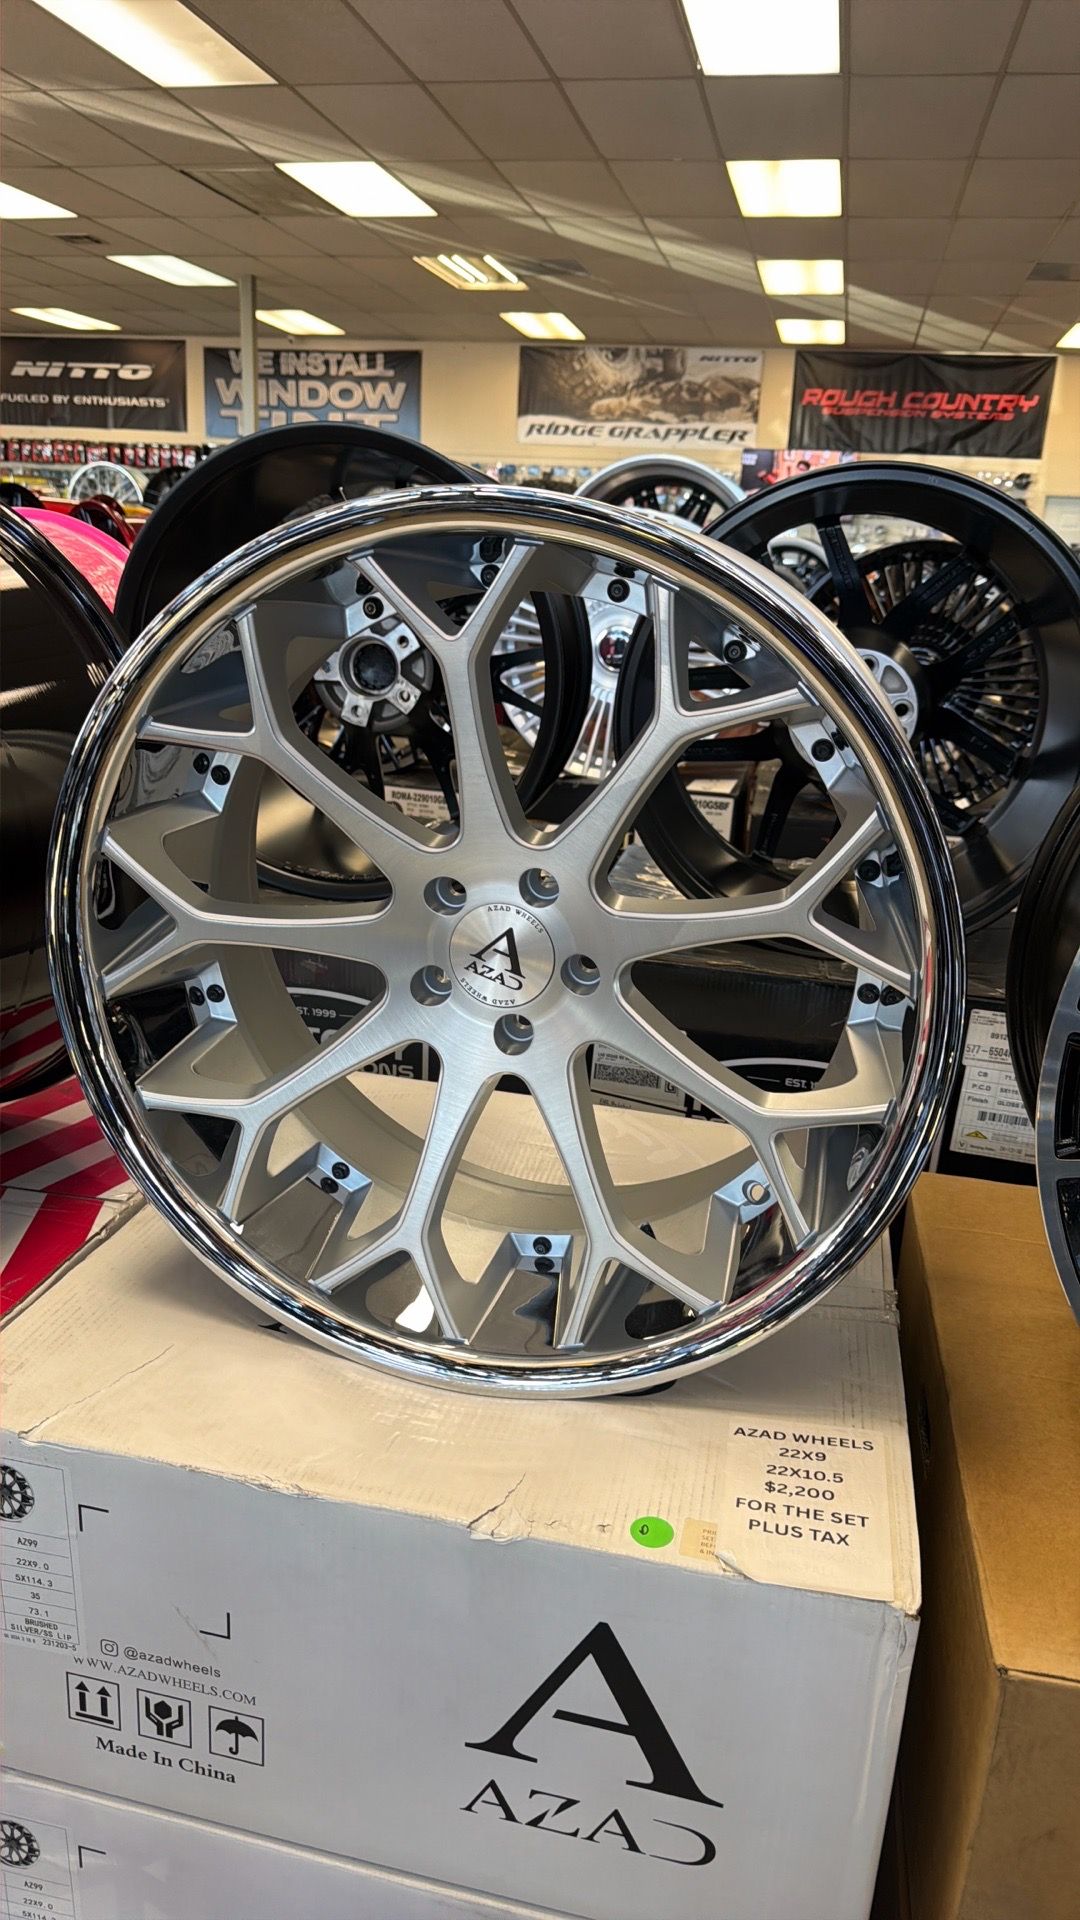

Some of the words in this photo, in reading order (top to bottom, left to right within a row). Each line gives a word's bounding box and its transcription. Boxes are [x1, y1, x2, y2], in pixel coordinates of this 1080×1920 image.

[279, 351, 395, 377] INSTALL
[700, 355, 758, 364] NITTO
[10, 360, 153, 381] NITTO
[0, 393, 49, 404] FUELED
[52, 394, 70, 405] BY
[73, 395, 166, 408] ENTHUSIASTS
[215, 378, 406, 410] WINDOW
[802, 388, 897, 408] ROUGH
[902, 391, 1040, 413] COUNTRY
[822, 406, 926, 418] SUSPENSION
[930, 410, 1014, 421] SYSTEMS
[526, 421, 603, 438] RIDGE
[608, 425, 752, 444] GRAPPLER
[487, 905, 511, 913] AZAD
[515, 908, 544, 934] WHEELS
[470, 927, 526, 979] A
[460, 977, 488, 1002] WHEELS
[492, 998, 516, 1006] AZAD
[296, 1006, 309, 1016] ST.
[312, 1008, 336, 1018] 1999
[784, 1077, 807, 1089] EST.
[734, 1427, 786, 1441] AZAD
[792, 1432, 875, 1451] WHEELS
[778, 1447, 827, 1462] 22X9
[766, 1464, 844, 1483] 22X10.5
[764, 1480, 835, 1501] $2,200
[735, 1497, 776, 1514] FOR
[782, 1504, 825, 1522] THE
[830, 1512, 869, 1528] SET
[748, 1518, 803, 1539] PLUS
[808, 1528, 850, 1547] TAX
[17, 1537, 38, 1548] AZ99
[16, 1557, 49, 1571] 22X9.0
[15, 1573, 53, 1587] 5X114.3
[30, 1591, 41, 1600] 35
[28, 1606, 49, 1617] 73.1
[10, 1623, 54, 1639] SILVER/SS
[57, 1632, 72, 1641] LIP
[24, 1617, 58, 1631] BRUSHED
[42, 1638, 77, 1651] 231203-5
[123, 1646, 221, 1678] @azadwheels
[73, 1655, 257, 1706] WWW.AZADWHEELS.COM
[464, 1621, 724, 1809] A
[95, 1735, 148, 1761] Made
[153, 1750, 174, 1768] In
[178, 1757, 236, 1784] China
[459, 1778, 717, 1866] AZAD
[24, 1880, 43, 1891] AZ99
[22, 1897, 53, 1910] 22X9.0
[22, 1910, 56, 1920] 5X114
